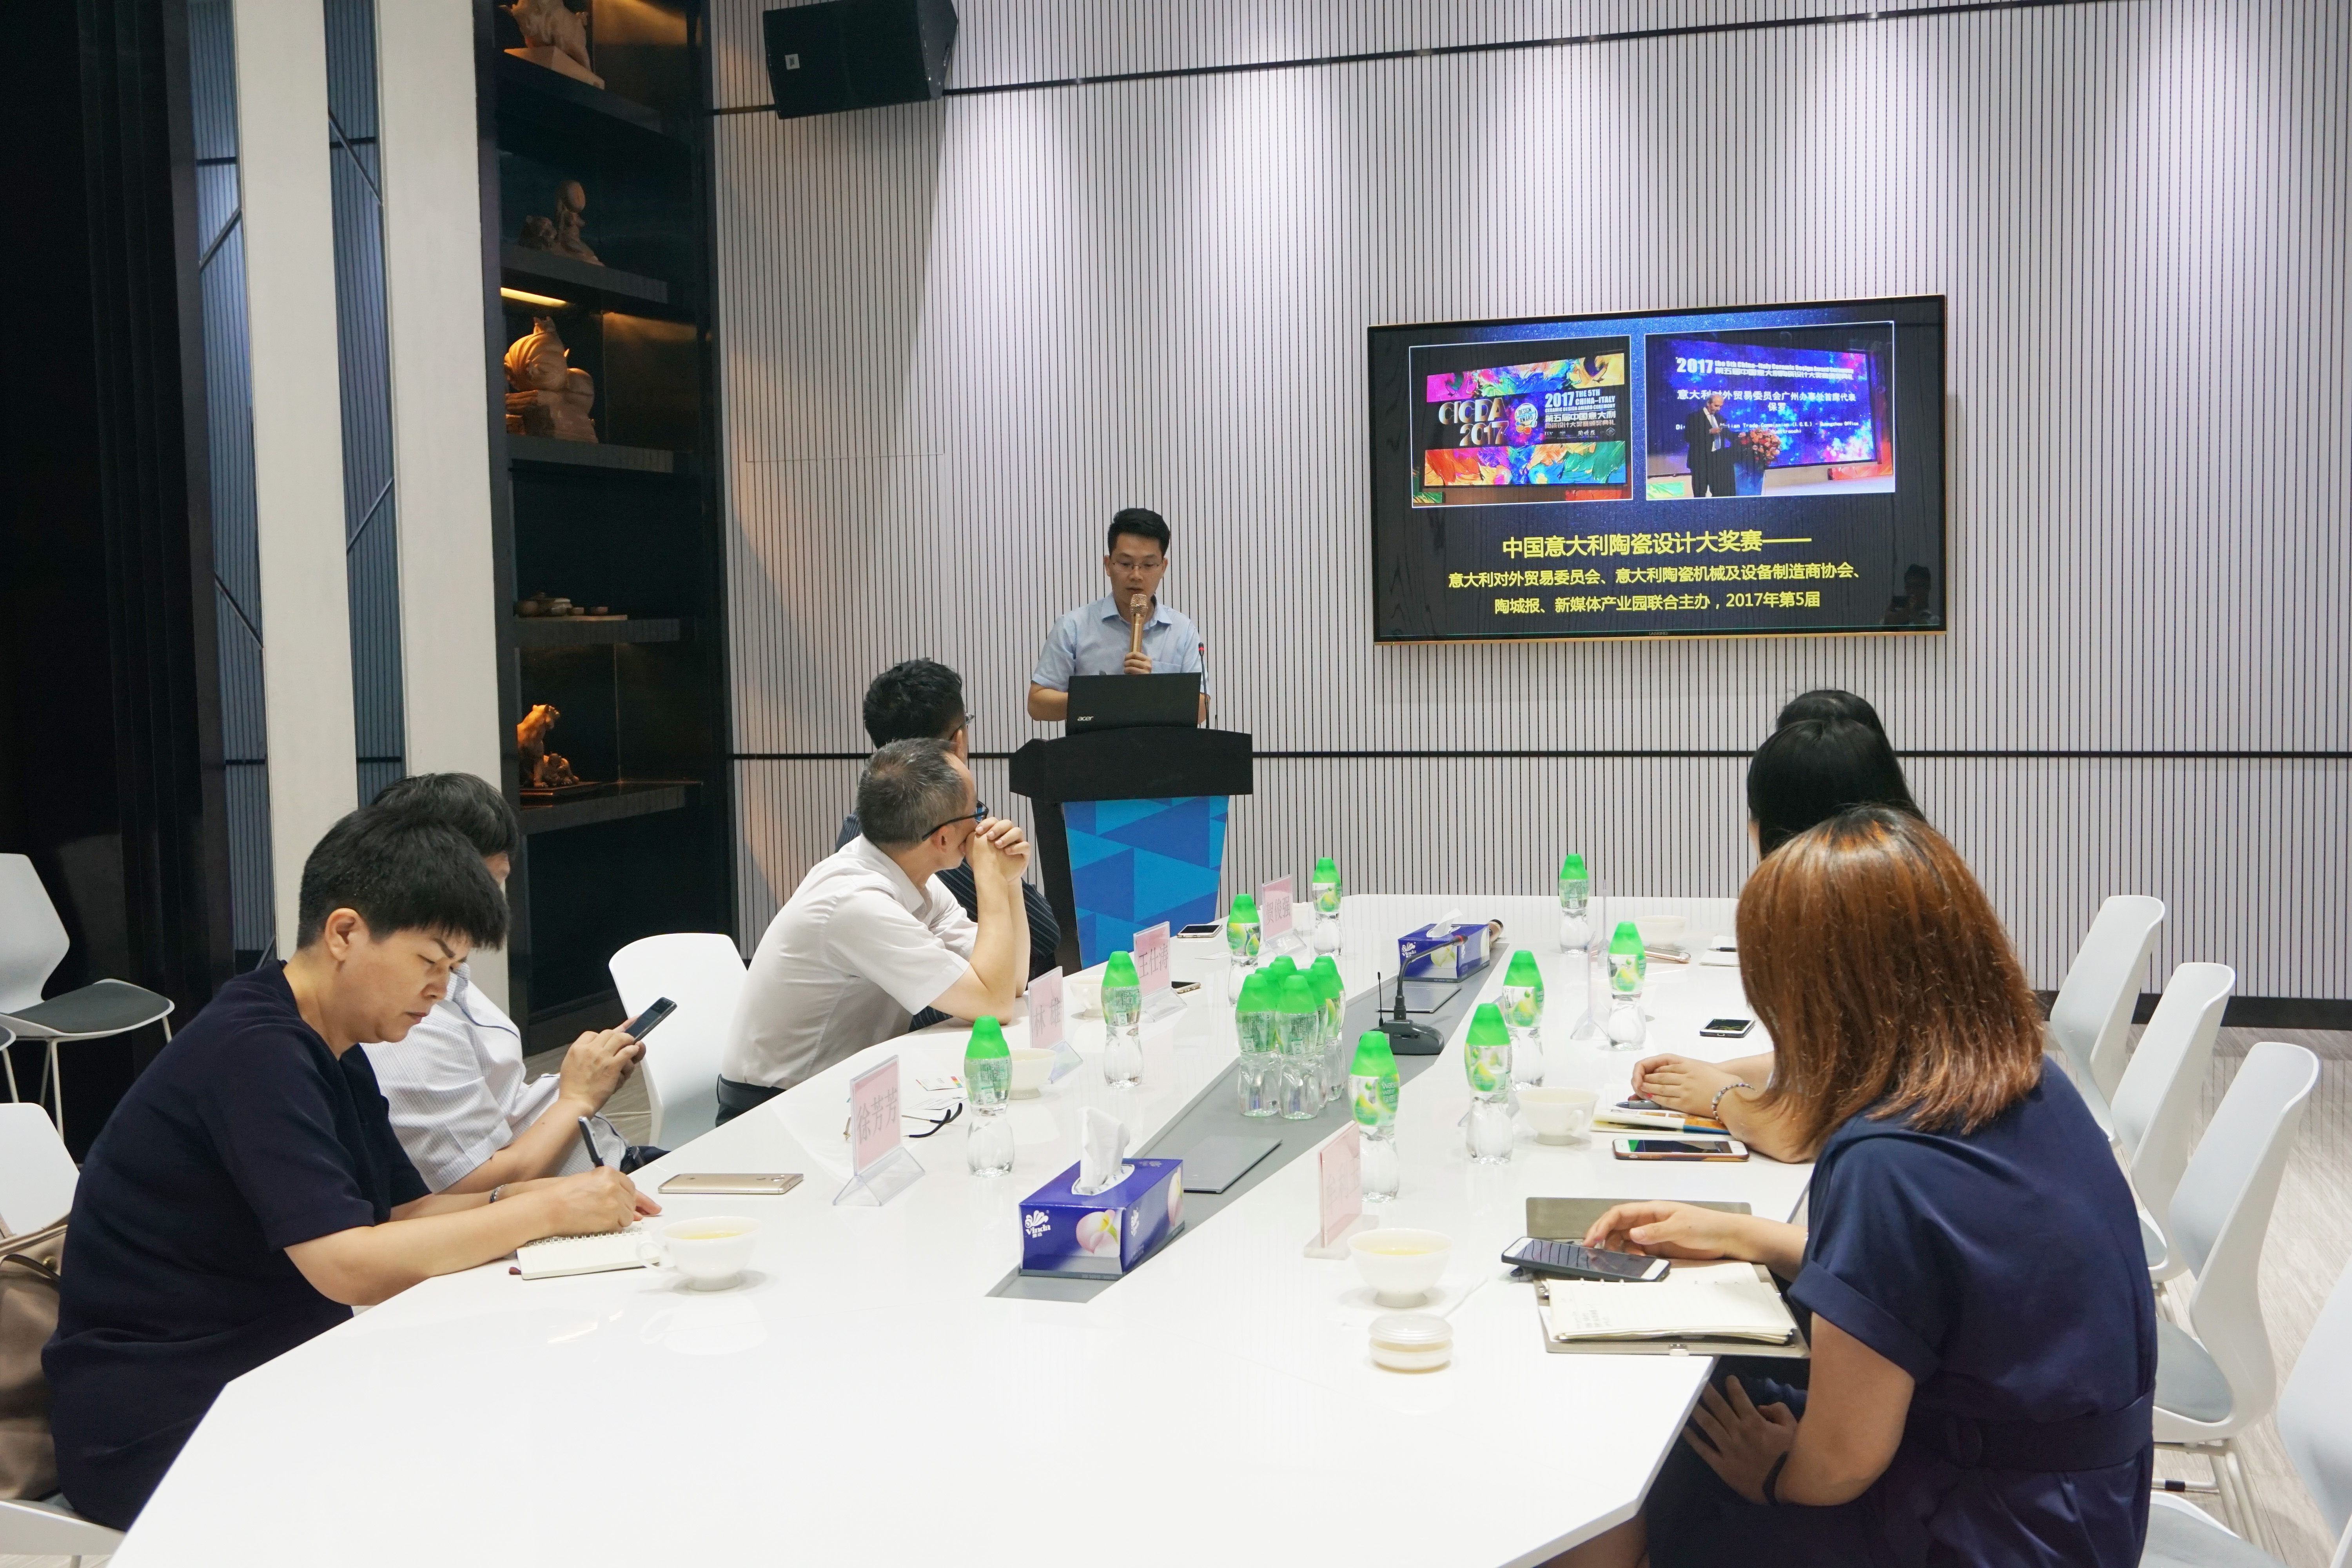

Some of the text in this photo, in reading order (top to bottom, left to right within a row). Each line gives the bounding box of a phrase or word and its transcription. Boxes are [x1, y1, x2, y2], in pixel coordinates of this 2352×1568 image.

[1677, 358, 1713, 374] 2017
[1545, 391, 1574, 408] 2017
[1768, 402, 1786, 411] 保罗
[1439, 397, 1506, 425] CICDA
[1519, 407, 1532, 416] DESIGN
[1545, 410, 1616, 423] 第五届中国意大利
[1459, 421, 1509, 446] 2017
[1266, 895, 1290, 925] 贺俊强
[1139, 943, 1169, 978] 王仕涛
[857, 1087, 897, 1145] 徐芳芳
